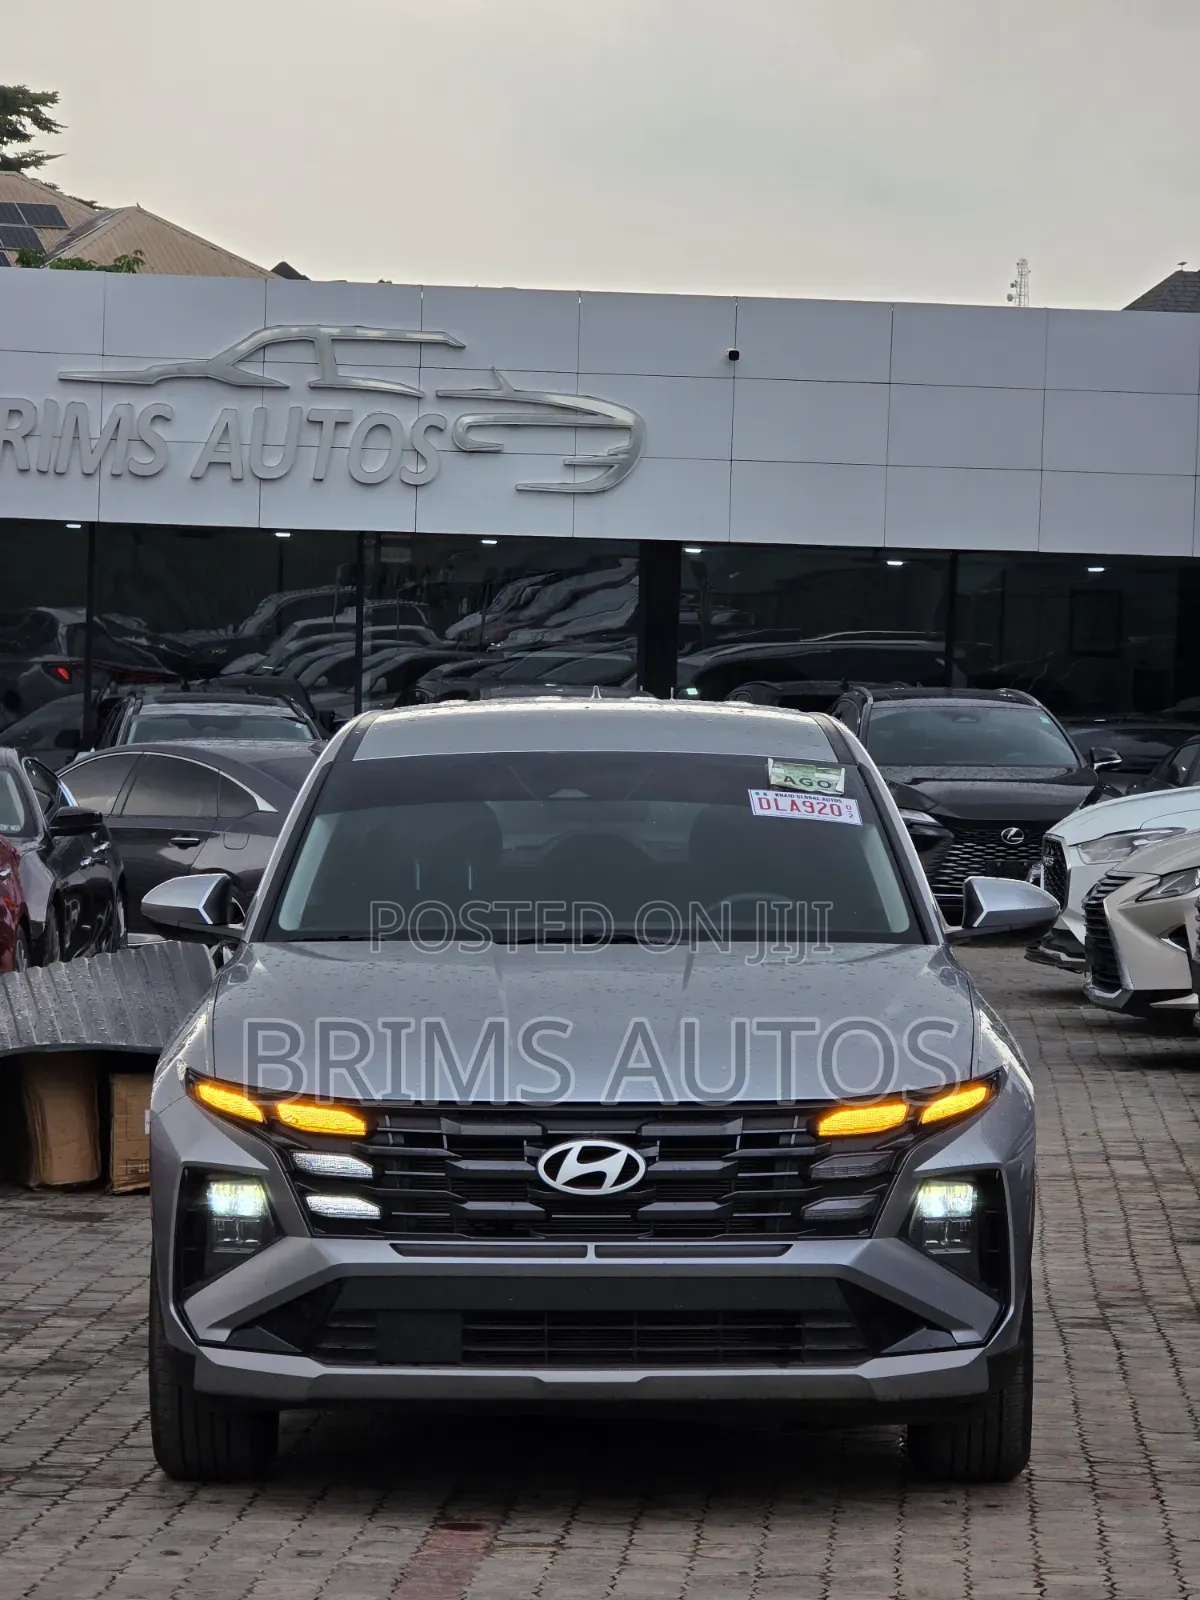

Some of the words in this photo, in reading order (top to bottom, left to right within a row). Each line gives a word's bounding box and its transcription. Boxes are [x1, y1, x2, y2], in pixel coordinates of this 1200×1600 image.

[190, 405, 448, 486] AUTOS
[783, 775, 832, 789] AGO
[758, 796, 843, 817] DLA920
